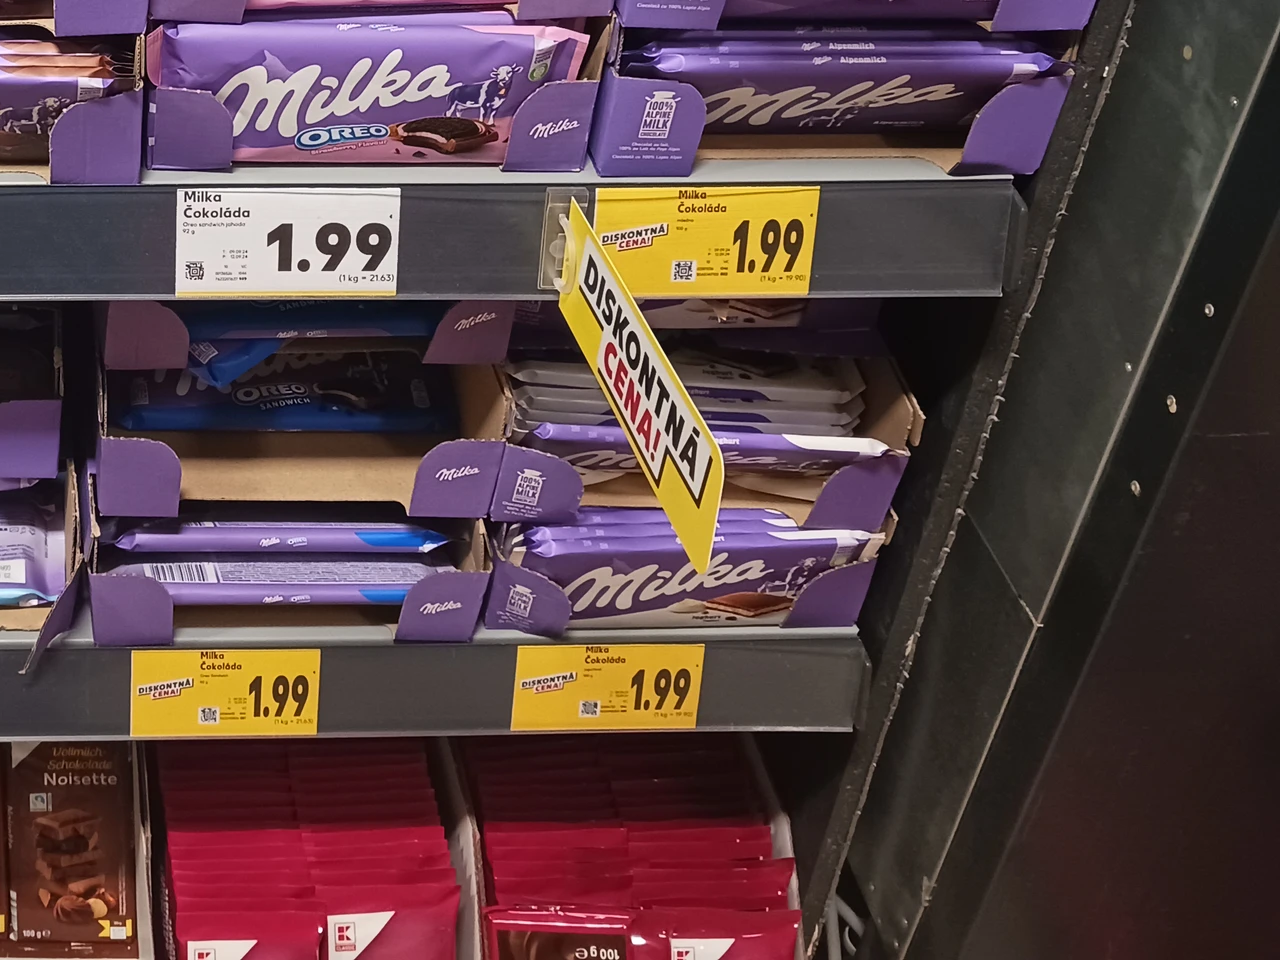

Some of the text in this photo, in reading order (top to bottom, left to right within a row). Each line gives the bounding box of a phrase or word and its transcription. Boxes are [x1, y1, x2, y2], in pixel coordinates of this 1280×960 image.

[215, 48, 463, 138] Milka
[707, 74, 964, 126] Milka
[299, 124, 388, 148] OREO
[184, 191, 221, 203] Milka
[678, 190, 707, 200] Milka
[183, 205, 250, 218] Čokoláda
[677, 202, 727, 213] Čokoláda
[602, 224, 666, 243] DISKONTNÁ
[267, 222, 392, 272] 1.99
[618, 236, 651, 249] CENA!
[732, 218, 805, 273] 1.99
[583, 254, 700, 482] DISKONTNÁ
[234, 381, 308, 402] OREO
[258, 396, 310, 411] SANDWICH
[604, 342, 662, 462] CENA!
[564, 552, 774, 612] Milka
[200, 652, 225, 660] Milka
[585, 655, 627, 664] Čokoláda
[200, 661, 242, 671] Čokoláda
[138, 678, 192, 694] DISKONTNÁ
[521, 672, 575, 688] DISKONTNÁ
[535, 682, 562, 692] CENA!
[248, 675, 310, 718] 1.99
[630, 668, 691, 711] 1.99
[44, 773, 118, 786] Noisette
